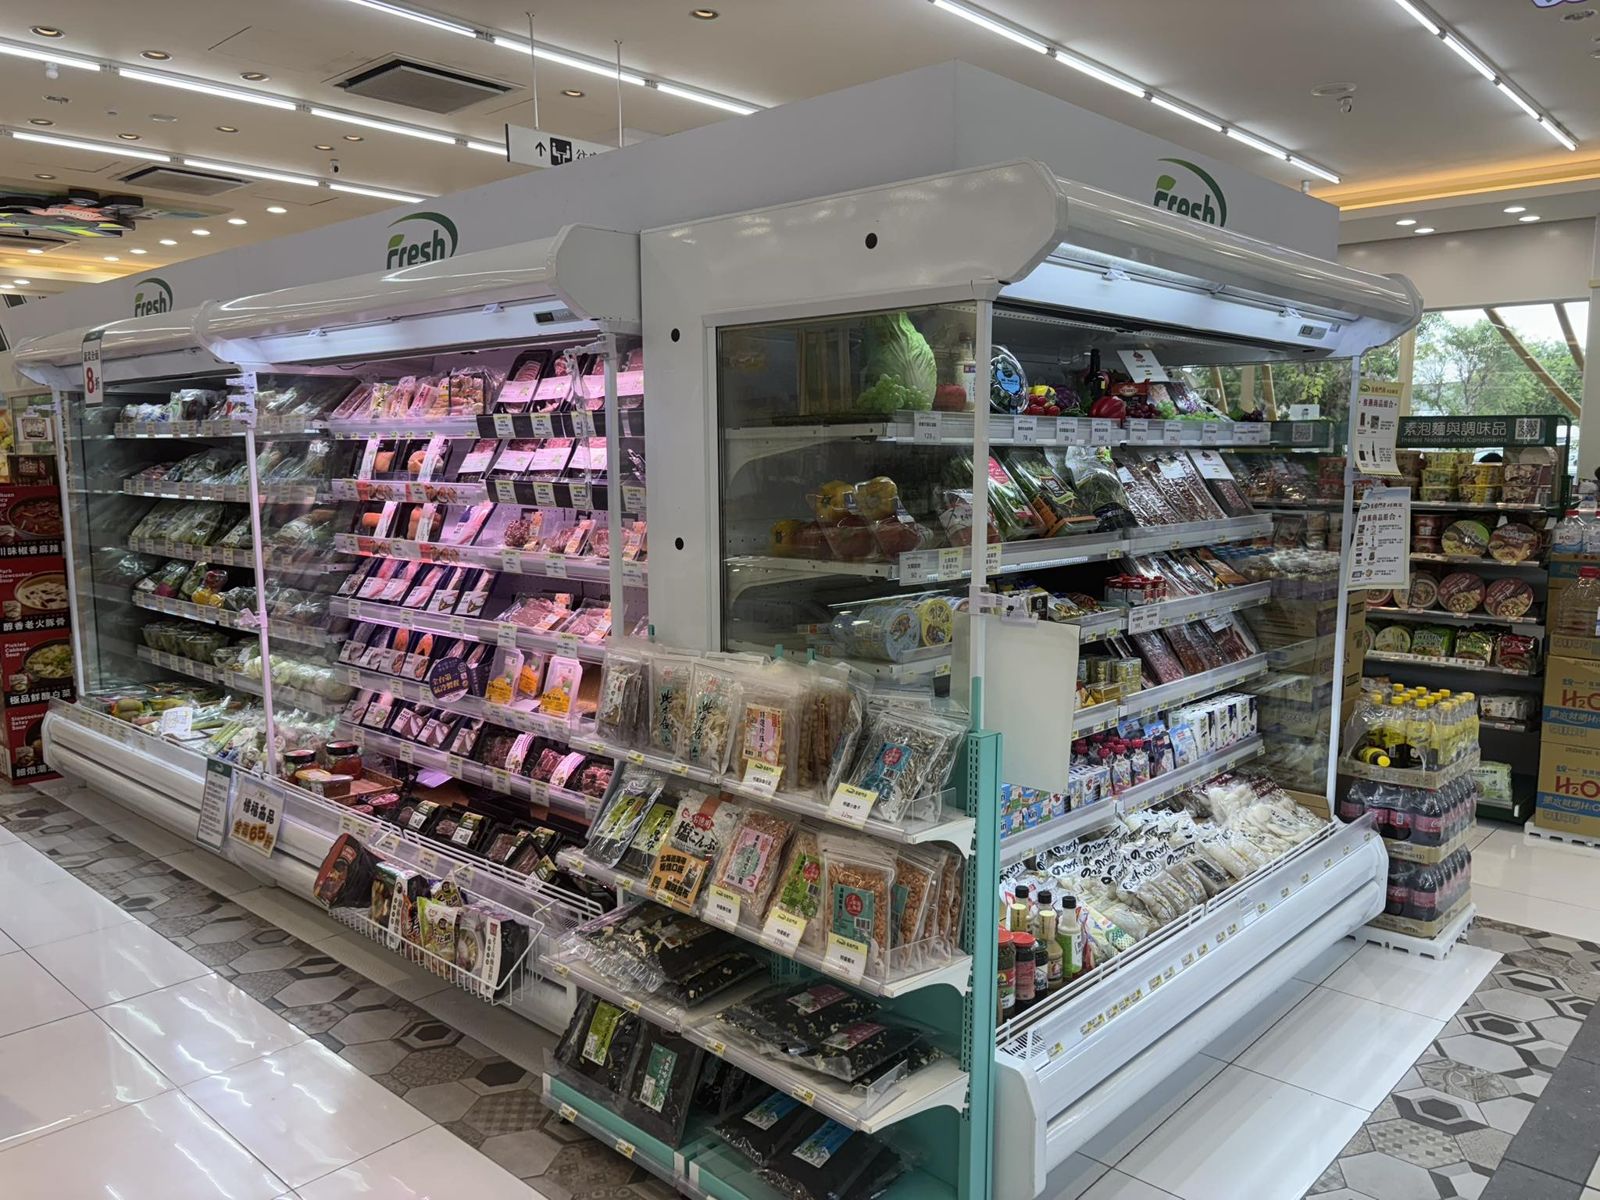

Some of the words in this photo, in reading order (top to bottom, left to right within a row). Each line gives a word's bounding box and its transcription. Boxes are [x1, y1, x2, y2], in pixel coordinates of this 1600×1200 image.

[1153, 175, 1215, 225] Fresh
[386, 229, 445, 270] Fresh
[134, 291, 167, 318] Fresh
[86, 367, 95, 394] 8
[1403, 421, 1507, 437] 素泡麵與調味品
[3, 617, 66, 632] 醇香老火豚骨
